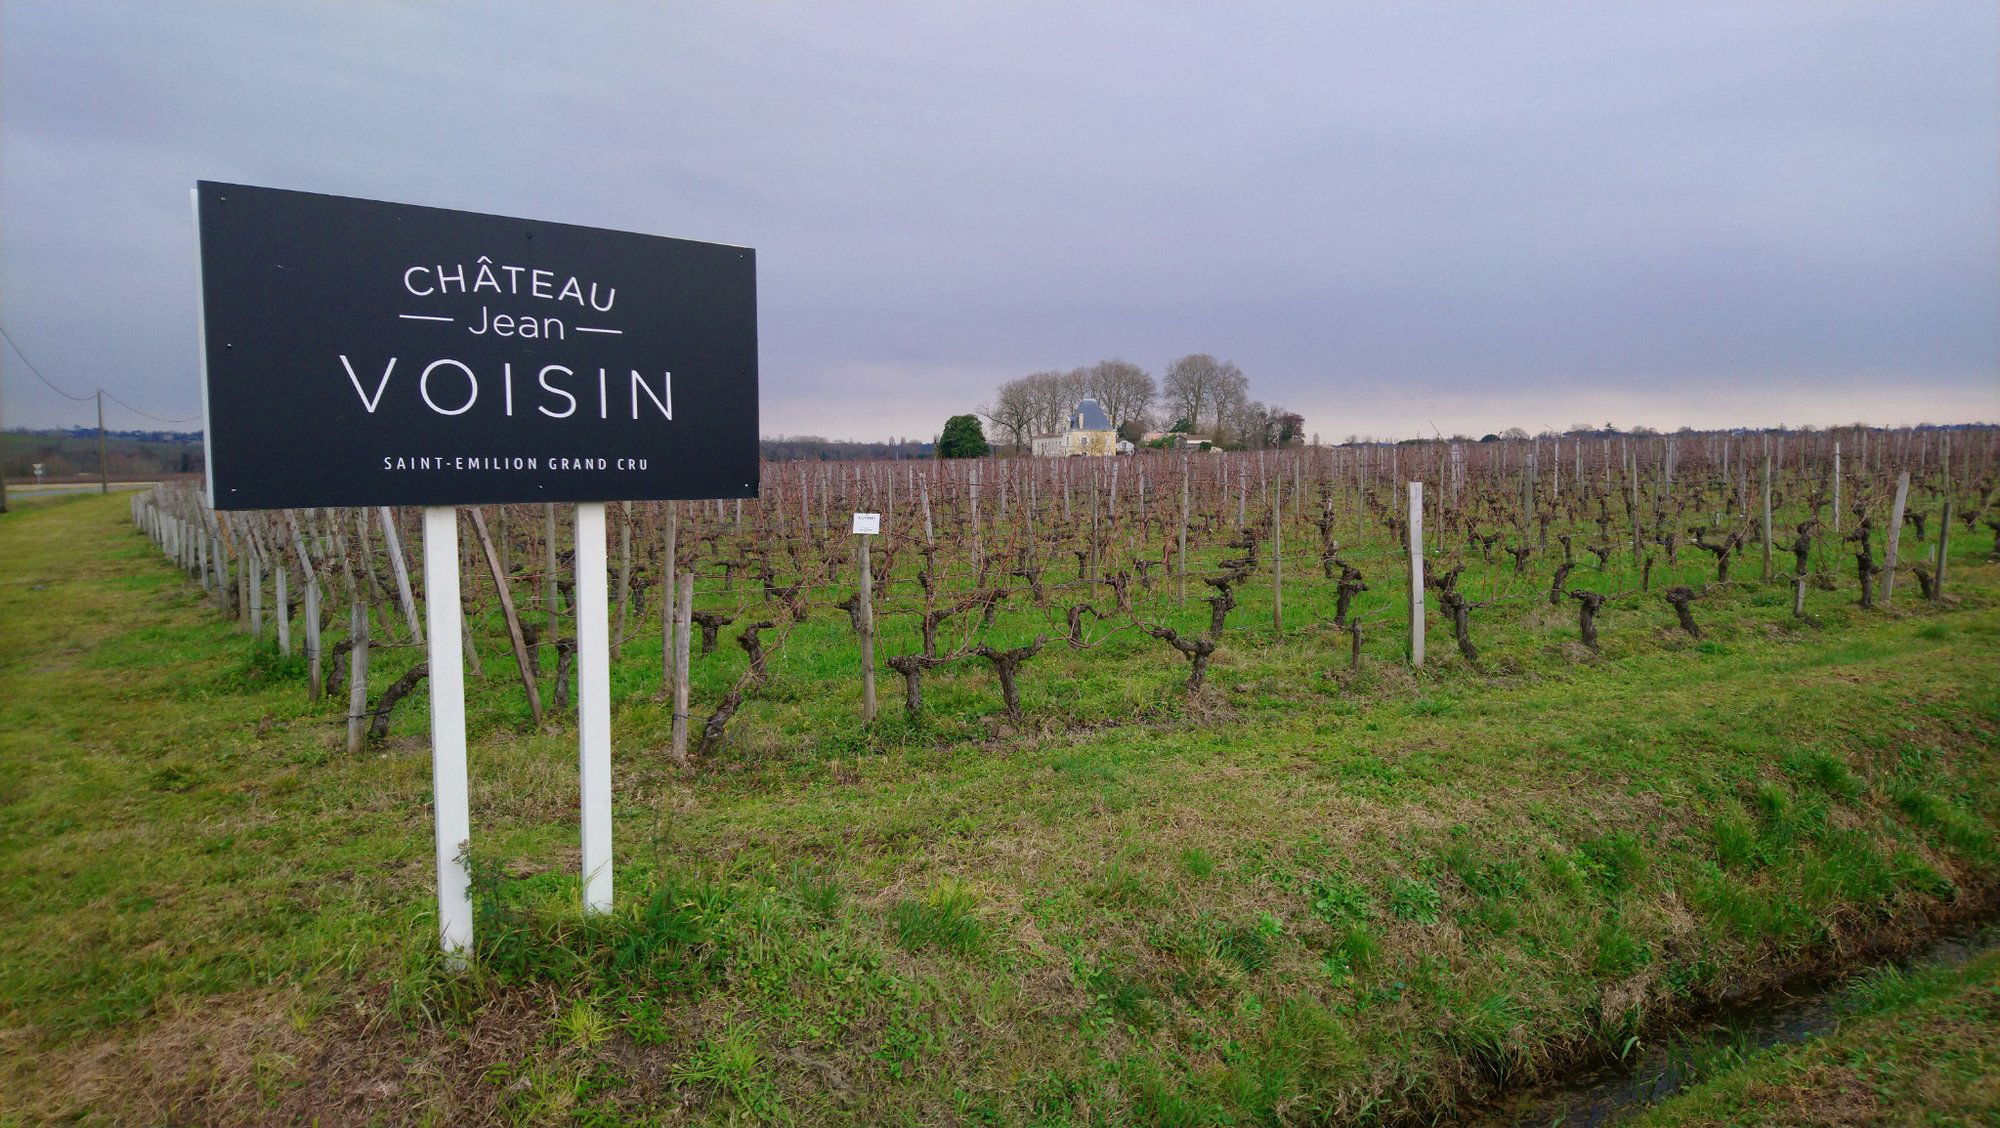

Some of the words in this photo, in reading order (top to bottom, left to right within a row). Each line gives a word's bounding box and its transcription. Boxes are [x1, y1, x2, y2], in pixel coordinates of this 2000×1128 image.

[403, 255, 616, 312] CHÂTEAU
[468, 306, 566, 340] Jean
[338, 354, 674, 421] VOISIN
[383, 456, 538, 471] SAINT-EMILION
[548, 457, 608, 471] GRAND
[617, 458, 649, 471] CRU
